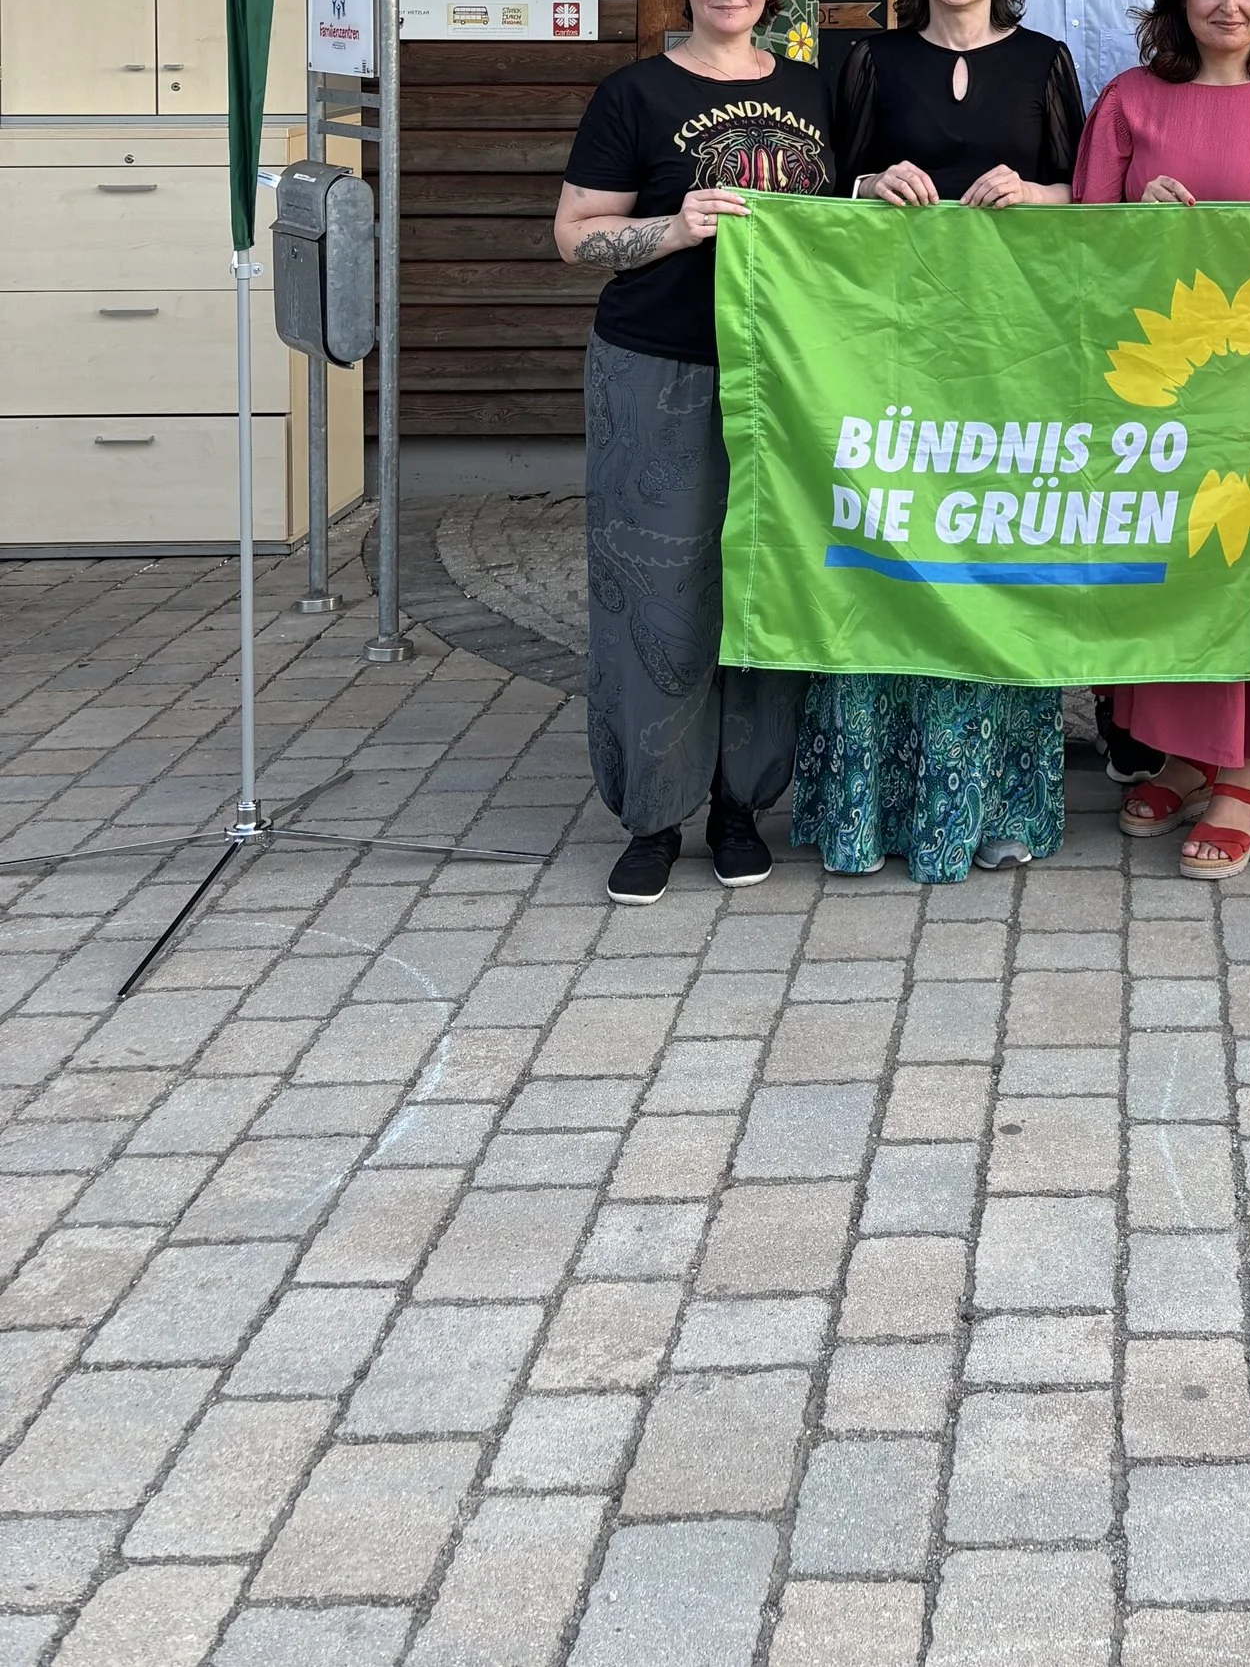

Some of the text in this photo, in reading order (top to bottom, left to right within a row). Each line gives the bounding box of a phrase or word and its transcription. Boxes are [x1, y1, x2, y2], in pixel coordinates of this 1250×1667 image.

[319, 21, 360, 41] Familienzentren
[554, 29, 578, 37] caritas
[673, 100, 825, 153] SCHANDMAUL
[833, 405, 1189, 474] BÜNDNIS 90
[832, 477, 1180, 545] DIE GRÜNEN
